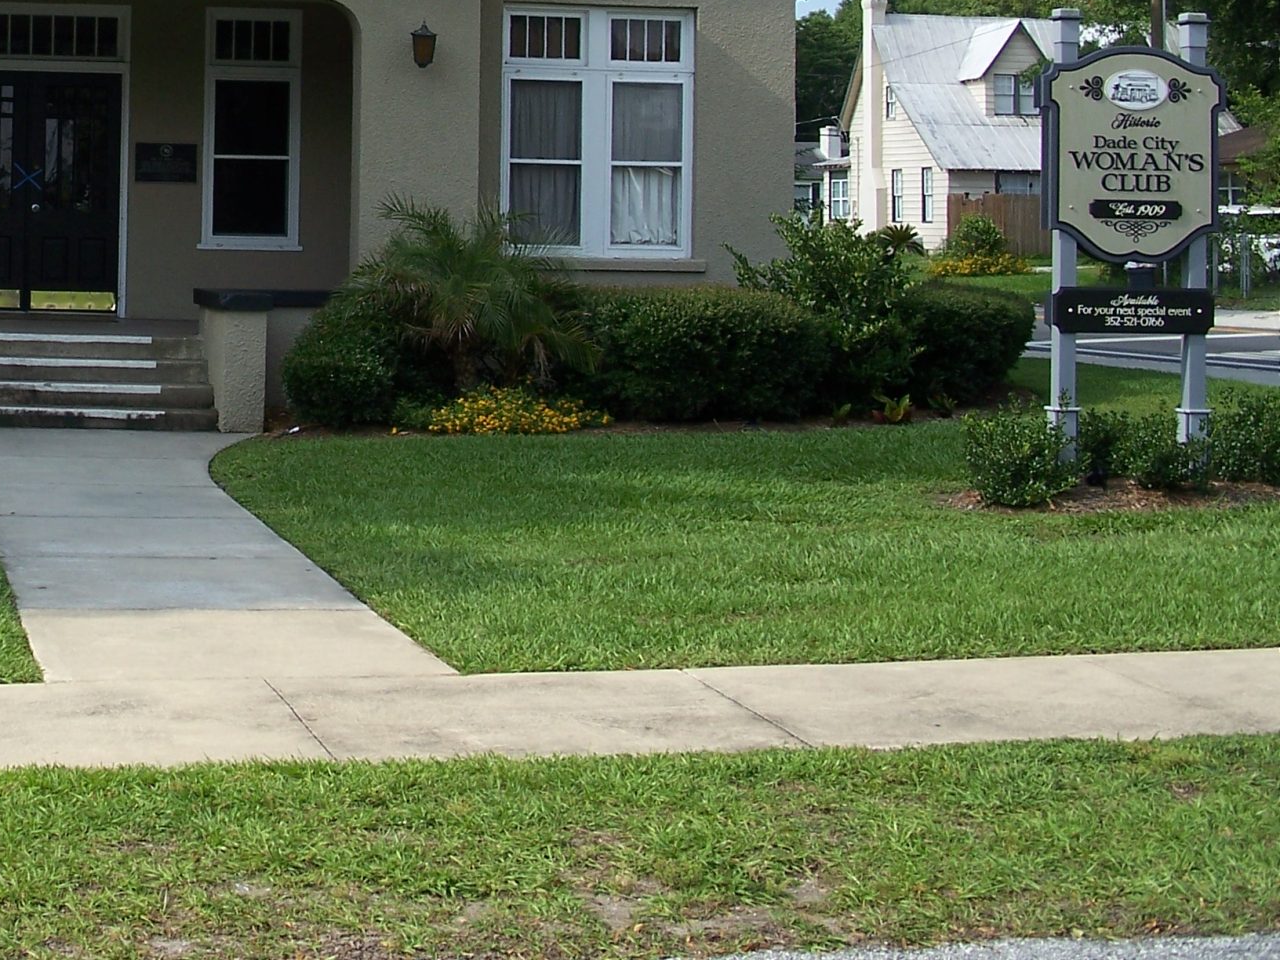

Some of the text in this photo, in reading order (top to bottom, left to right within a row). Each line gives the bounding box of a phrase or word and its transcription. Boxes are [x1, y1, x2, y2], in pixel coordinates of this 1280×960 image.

[1111, 113, 1161, 129] Historic
[1093, 135, 1179, 153] Dade City
[1068, 151, 1204, 171] WOMAN'S
[1101, 173, 1171, 192] CLUB
[1109, 202, 1166, 216] Est. 1909
[1110, 294, 1159, 306] Available
[1077, 304, 1192, 318] For your next special event
